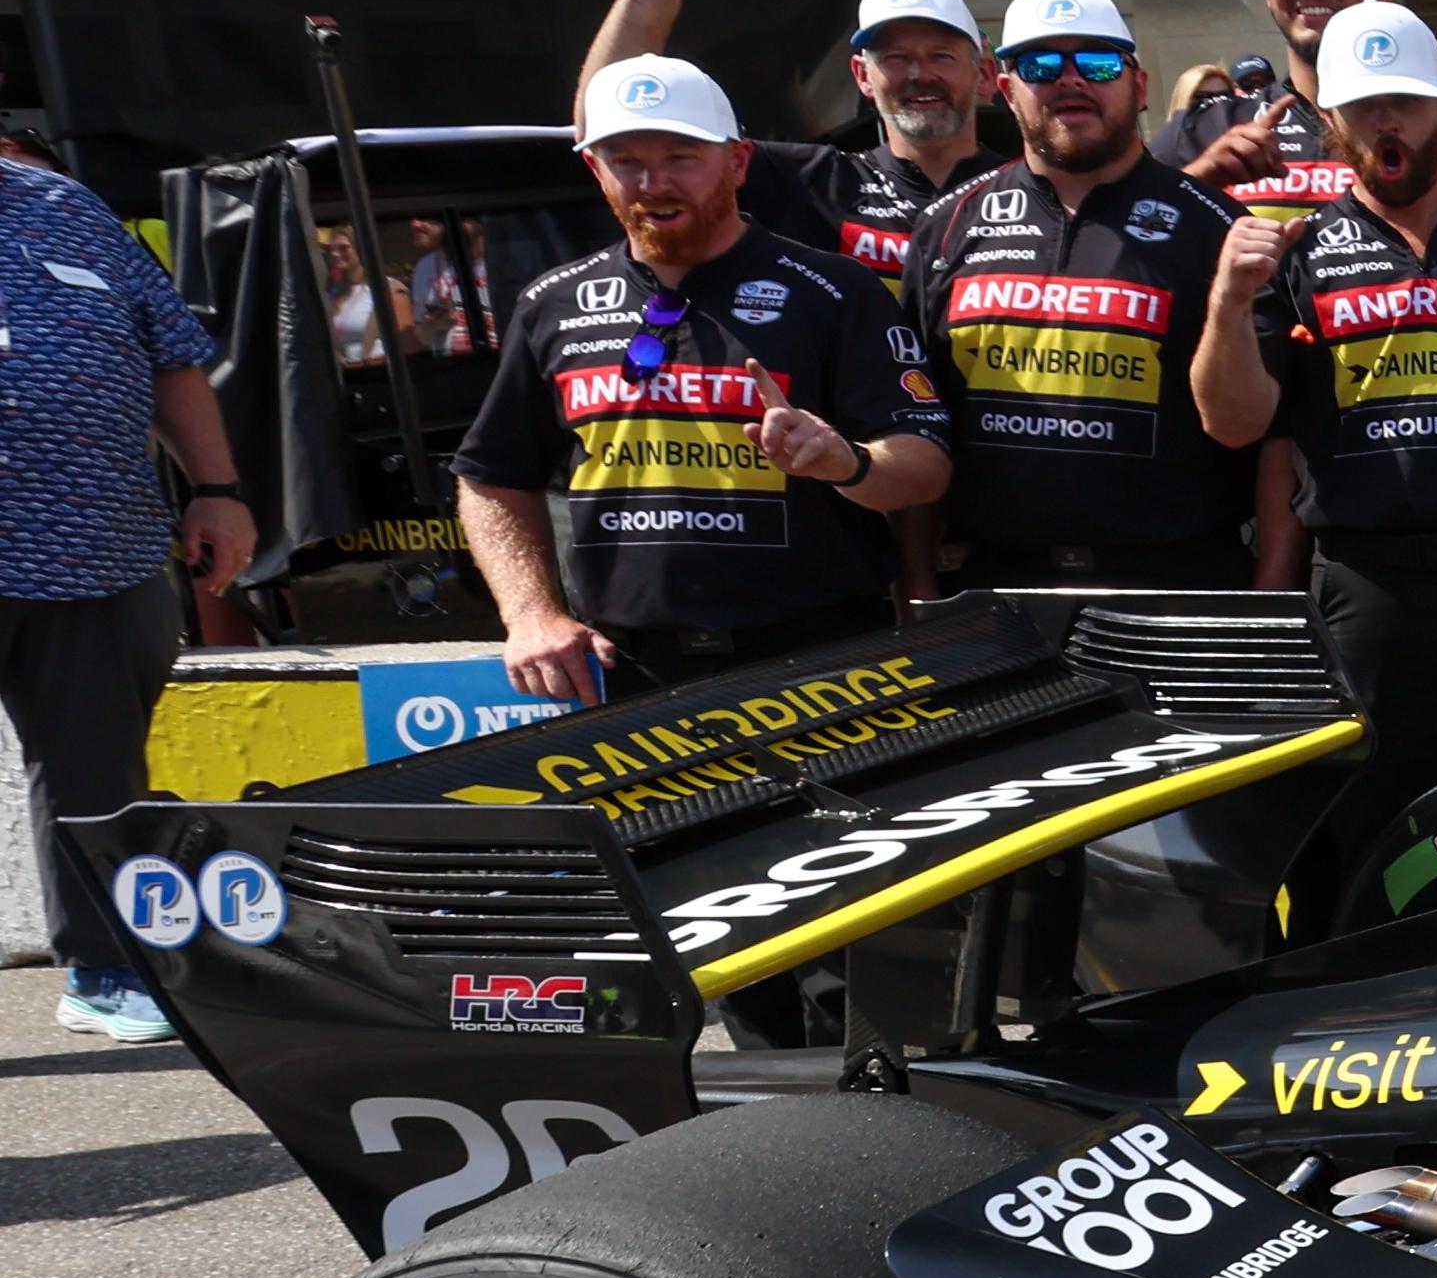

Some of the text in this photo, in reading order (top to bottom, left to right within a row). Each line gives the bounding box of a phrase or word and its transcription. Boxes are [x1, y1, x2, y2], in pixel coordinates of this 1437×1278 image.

[964, 249, 1036, 265] GROUP1001
[1316, 261, 1394, 279] GROUP1001
[733, 296, 786, 309] INDYCAR
[958, 281, 1159, 323] ANDRETTI
[559, 311, 643, 331] HONDA
[987, 344, 1146, 382] GAINBRIDGE
[571, 371, 757, 410] ANDRETT
[981, 412, 1113, 441] GROUP1001
[602, 439, 770, 471] GAINBRIDGE
[337, 519, 468, 552] GAINBRI
[600, 510, 745, 533] GROUP1001
[451, 975, 587, 1022] HRC
[451, 1021, 585, 1034] Honda RACING
[1271, 1033, 1437, 1115] visit
[983, 1124, 1169, 1237] GROUP
